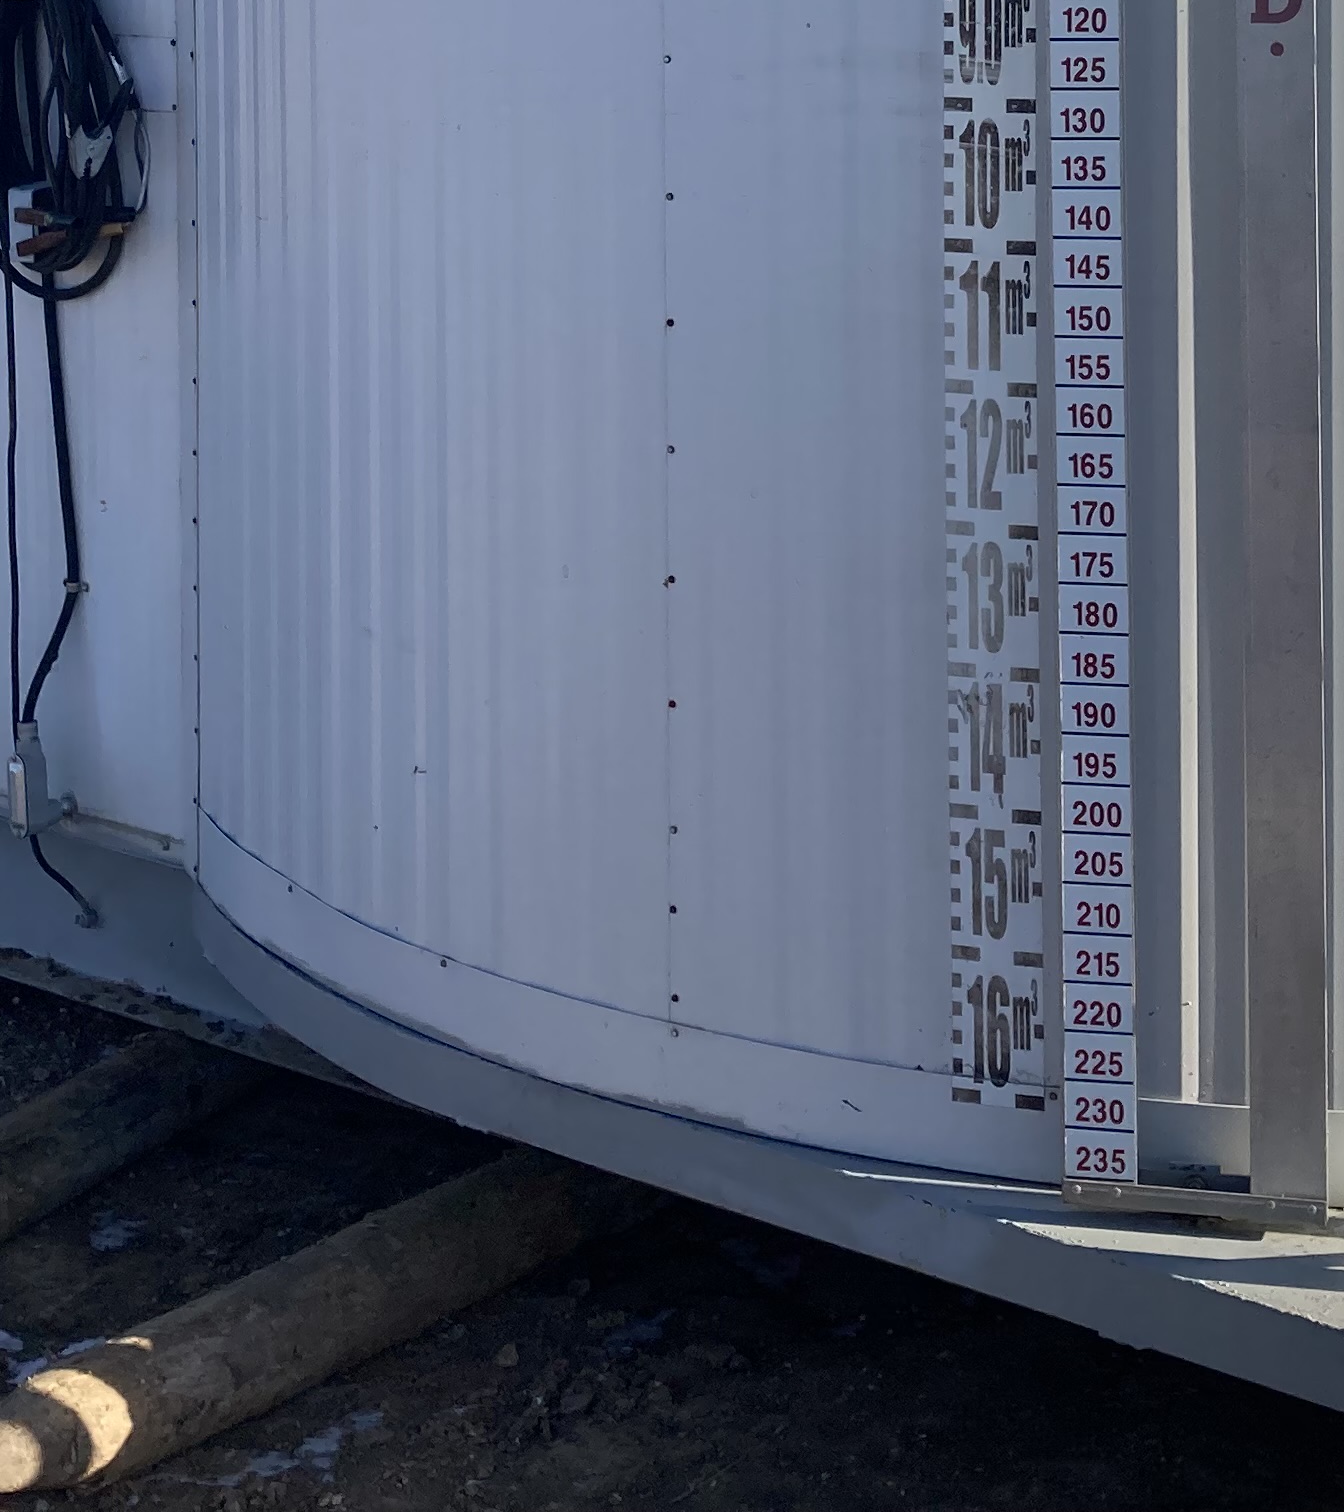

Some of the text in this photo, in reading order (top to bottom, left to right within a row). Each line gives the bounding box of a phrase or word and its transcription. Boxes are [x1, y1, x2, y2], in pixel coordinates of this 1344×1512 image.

[1064, 8, 1109, 34] 120
[1062, 56, 1106, 84] 125
[1060, 108, 1106, 134] 130
[1062, 156, 1106, 182] 135
[1066, 206, 1112, 233] 140
[1066, 255, 1111, 281] 145
[1067, 305, 1111, 333] 150
[1067, 354, 1111, 382] 155
[1068, 403, 1113, 430] 160
[1068, 452, 1113, 480] 165
[1072, 500, 1116, 528] 170
[1071, 551, 1114, 578] 175
[1074, 601, 1118, 630] 180
[1073, 652, 1116, 680] 185
[1072, 701, 1118, 729] 190
[1073, 752, 1118, 779] 195
[1072, 800, 1123, 829] 200
[1074, 849, 1125, 878] 205
[1076, 900, 1122, 930] 210
[1076, 950, 1121, 978] 215
[1072, 999, 1123, 1028] 220
[1075, 1048, 1124, 1078] 225
[1075, 1096, 1125, 1125] 230
[1075, 1145, 1126, 1174] 235
